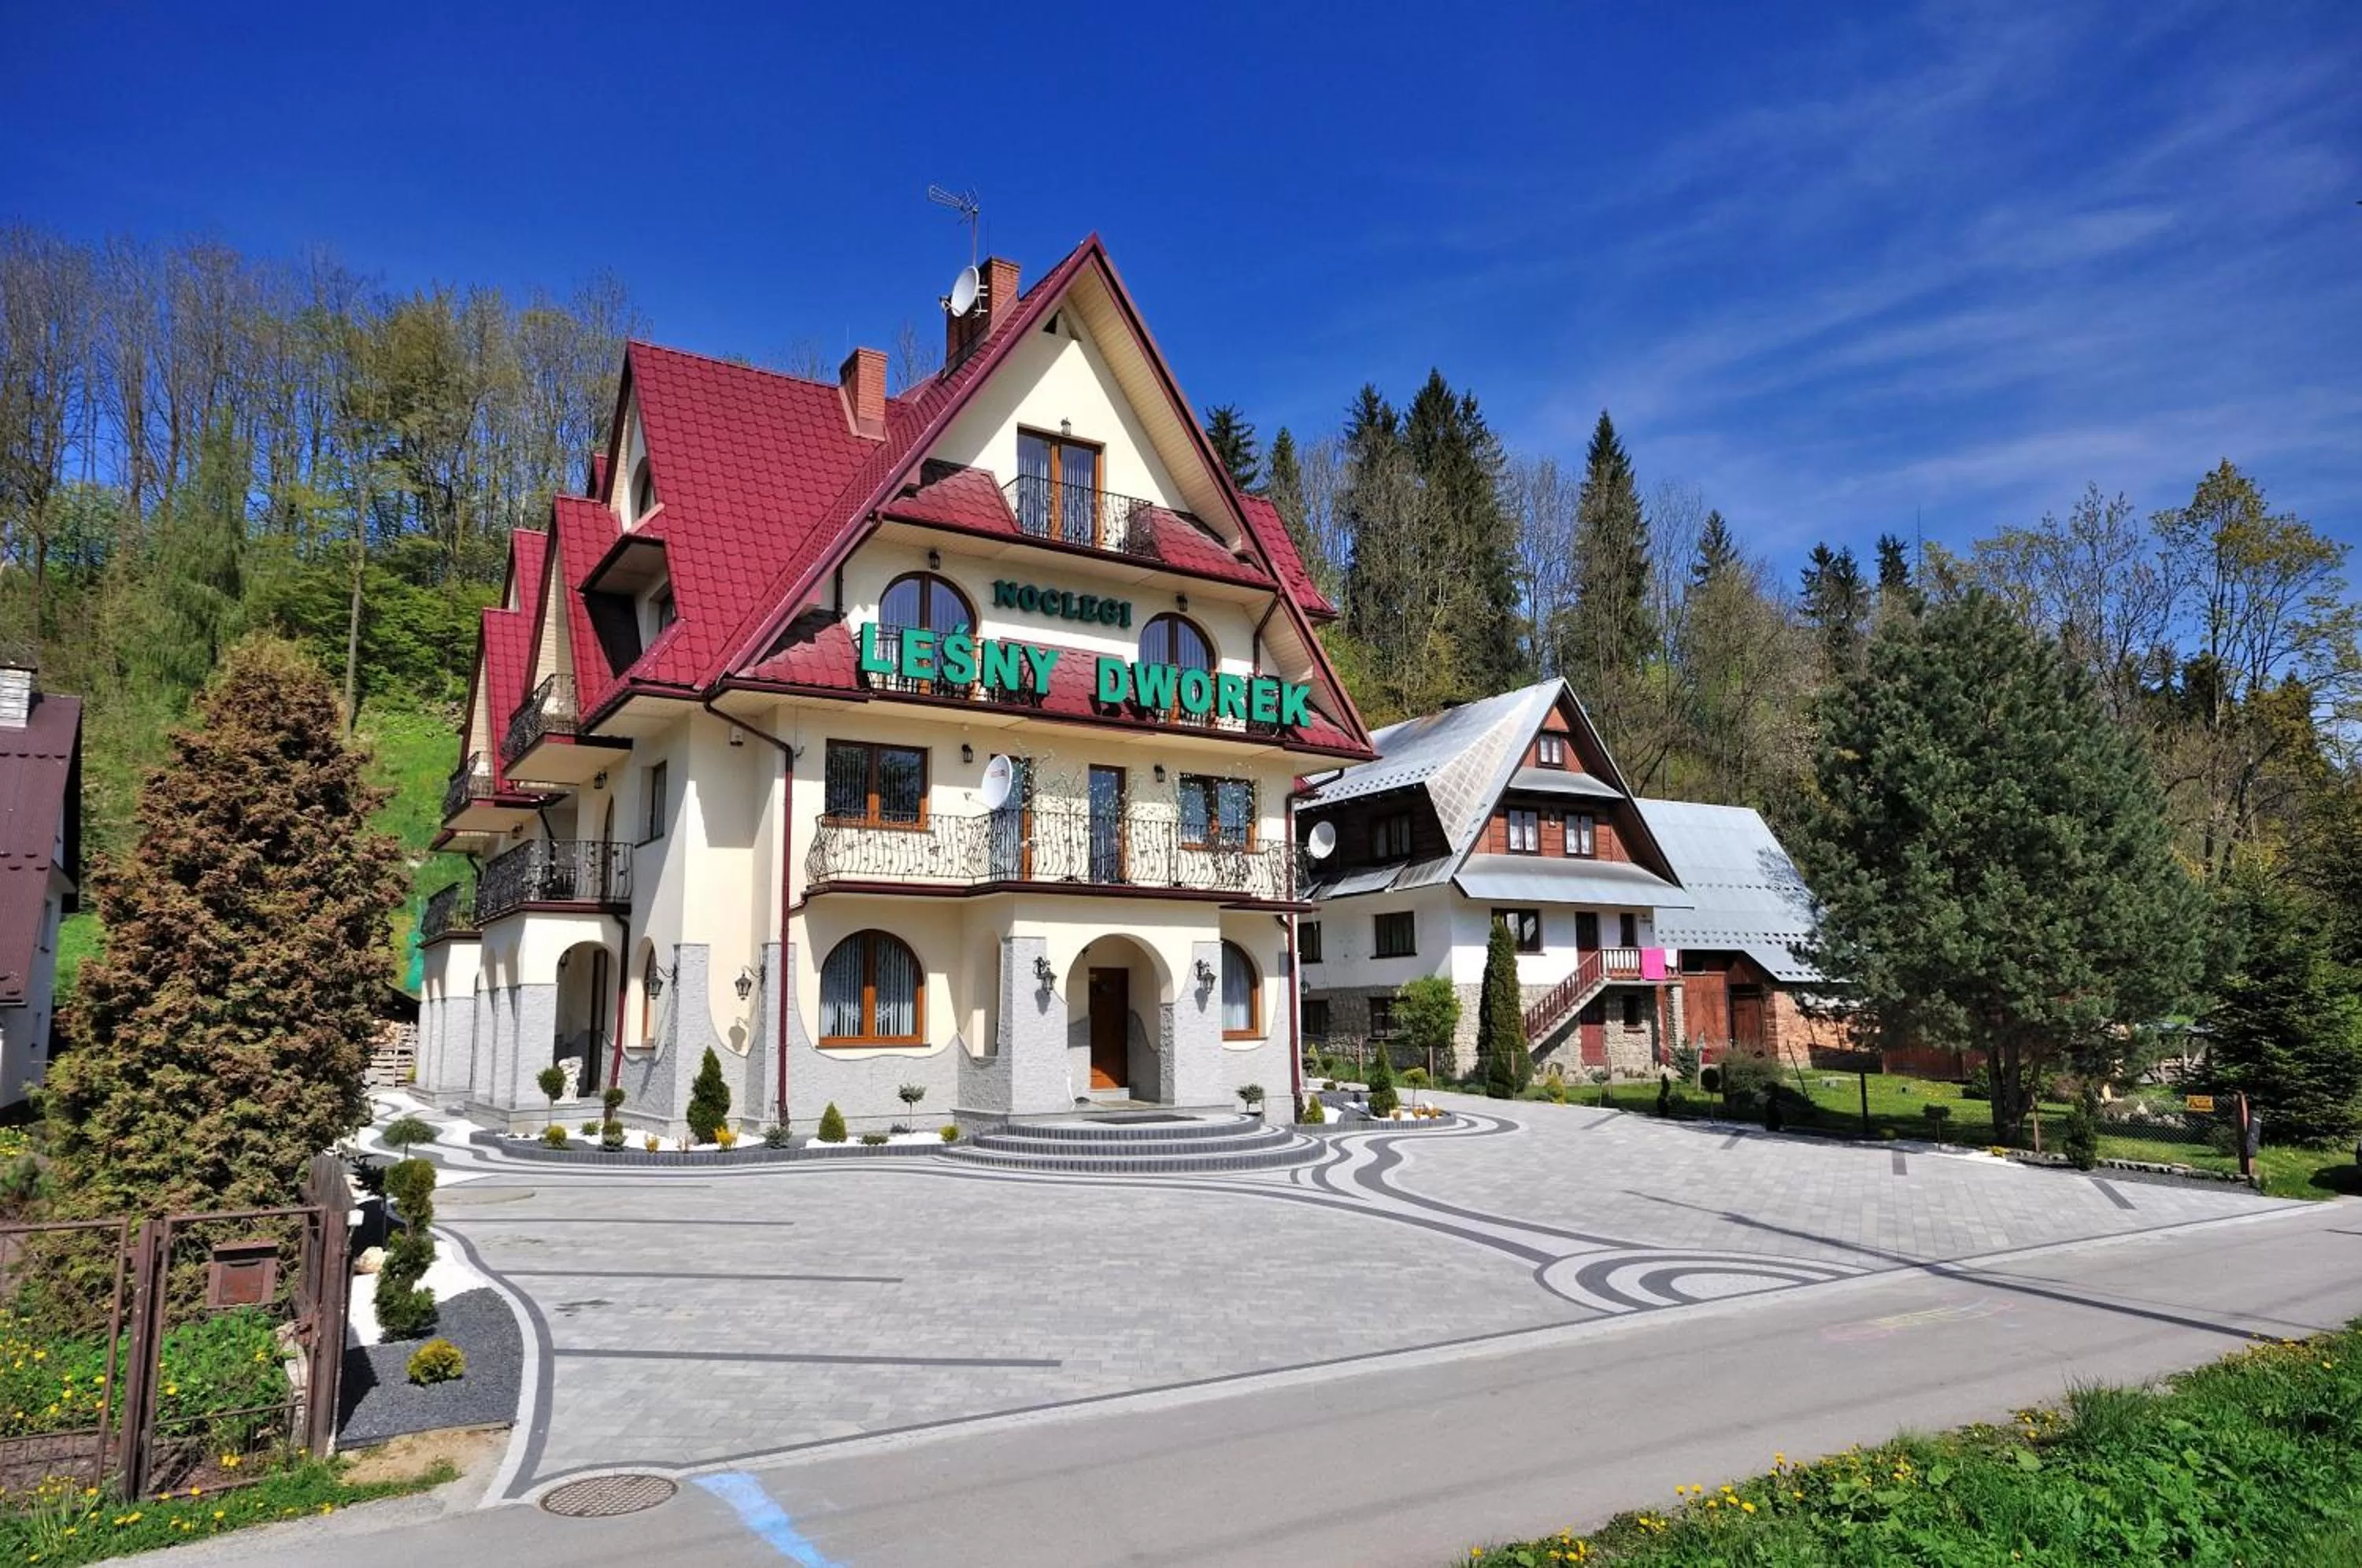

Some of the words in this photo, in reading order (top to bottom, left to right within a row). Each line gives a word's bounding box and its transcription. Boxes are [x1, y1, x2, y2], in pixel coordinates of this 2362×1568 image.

[993, 579, 1132, 628] NOCLEGI
[861, 621, 1059, 695] LEŚNY
[1096, 656, 1311, 727] DWOREK
